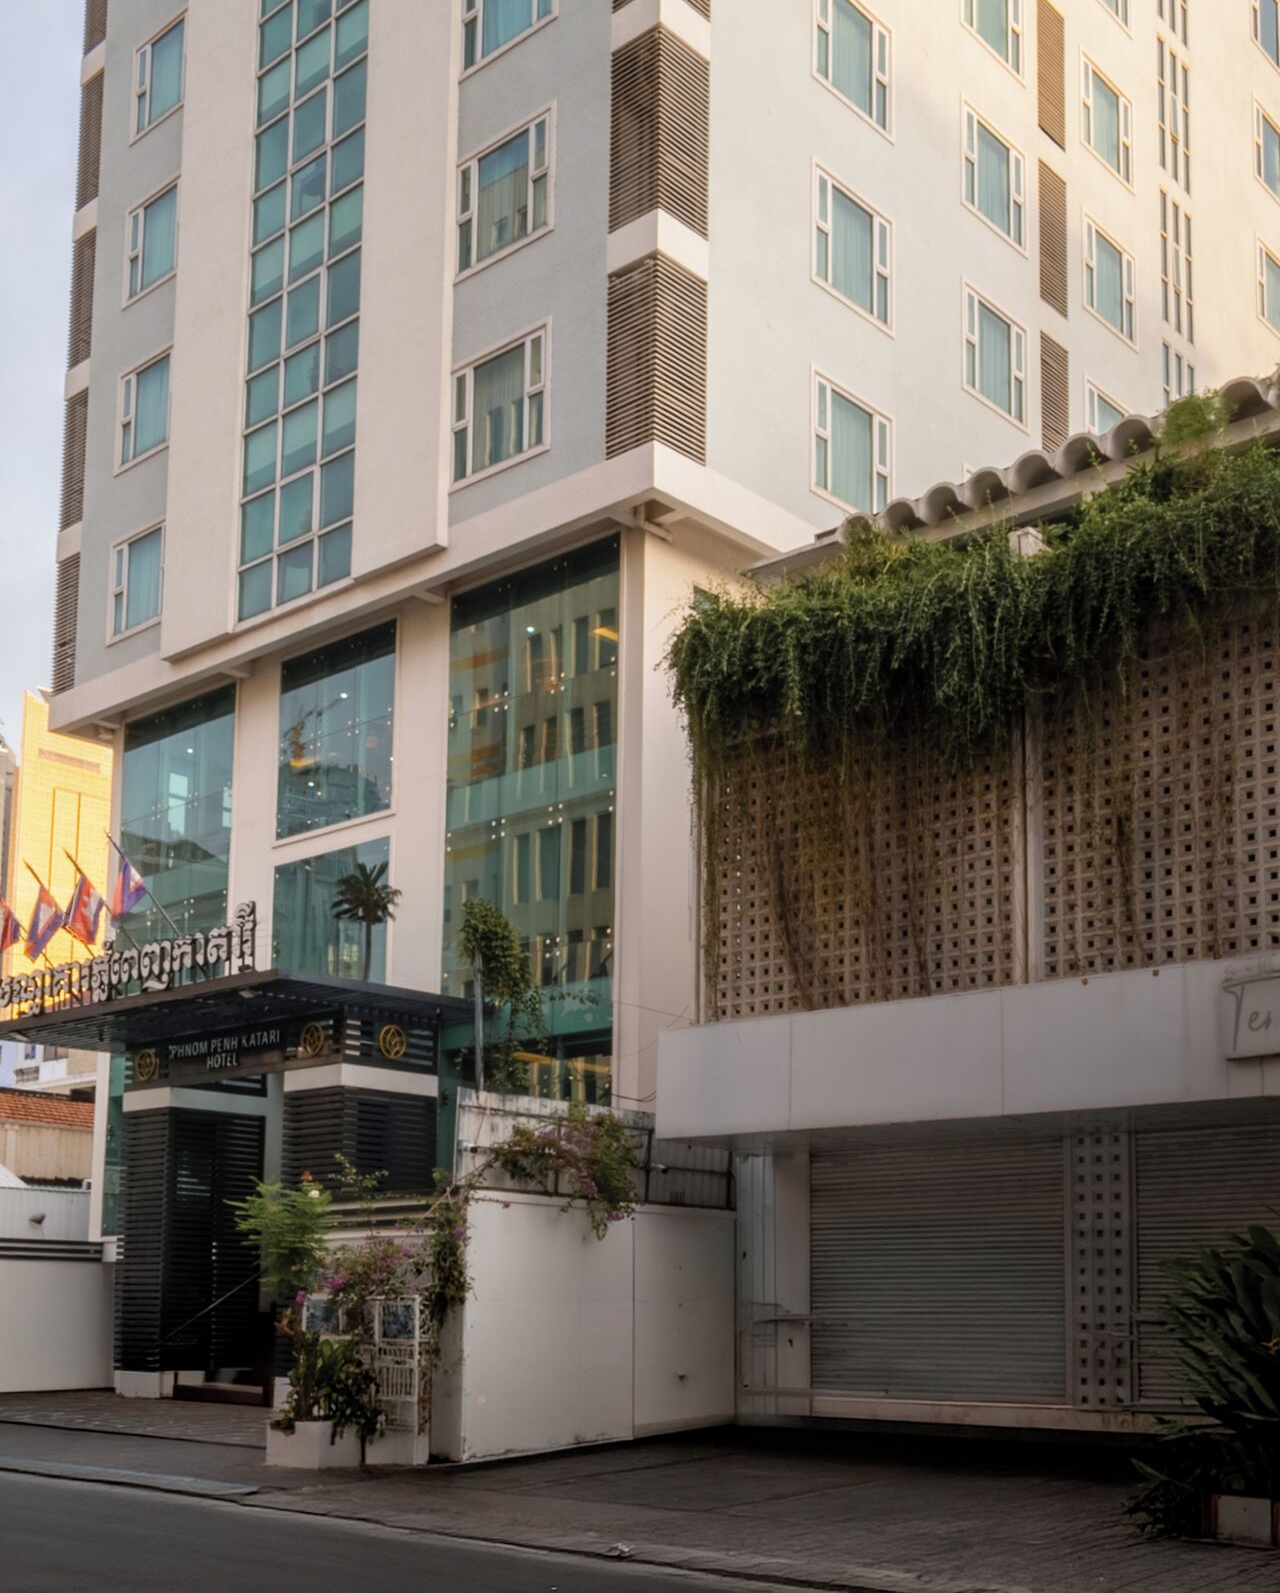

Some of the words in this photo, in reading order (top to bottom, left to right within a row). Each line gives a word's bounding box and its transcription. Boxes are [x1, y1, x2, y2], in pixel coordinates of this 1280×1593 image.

[169, 1040, 208, 1059] PHNOM
[210, 1037, 238, 1053] PENH
[241, 1030, 280, 1048] KATARI
[207, 1052, 238, 1069] HOTEL
